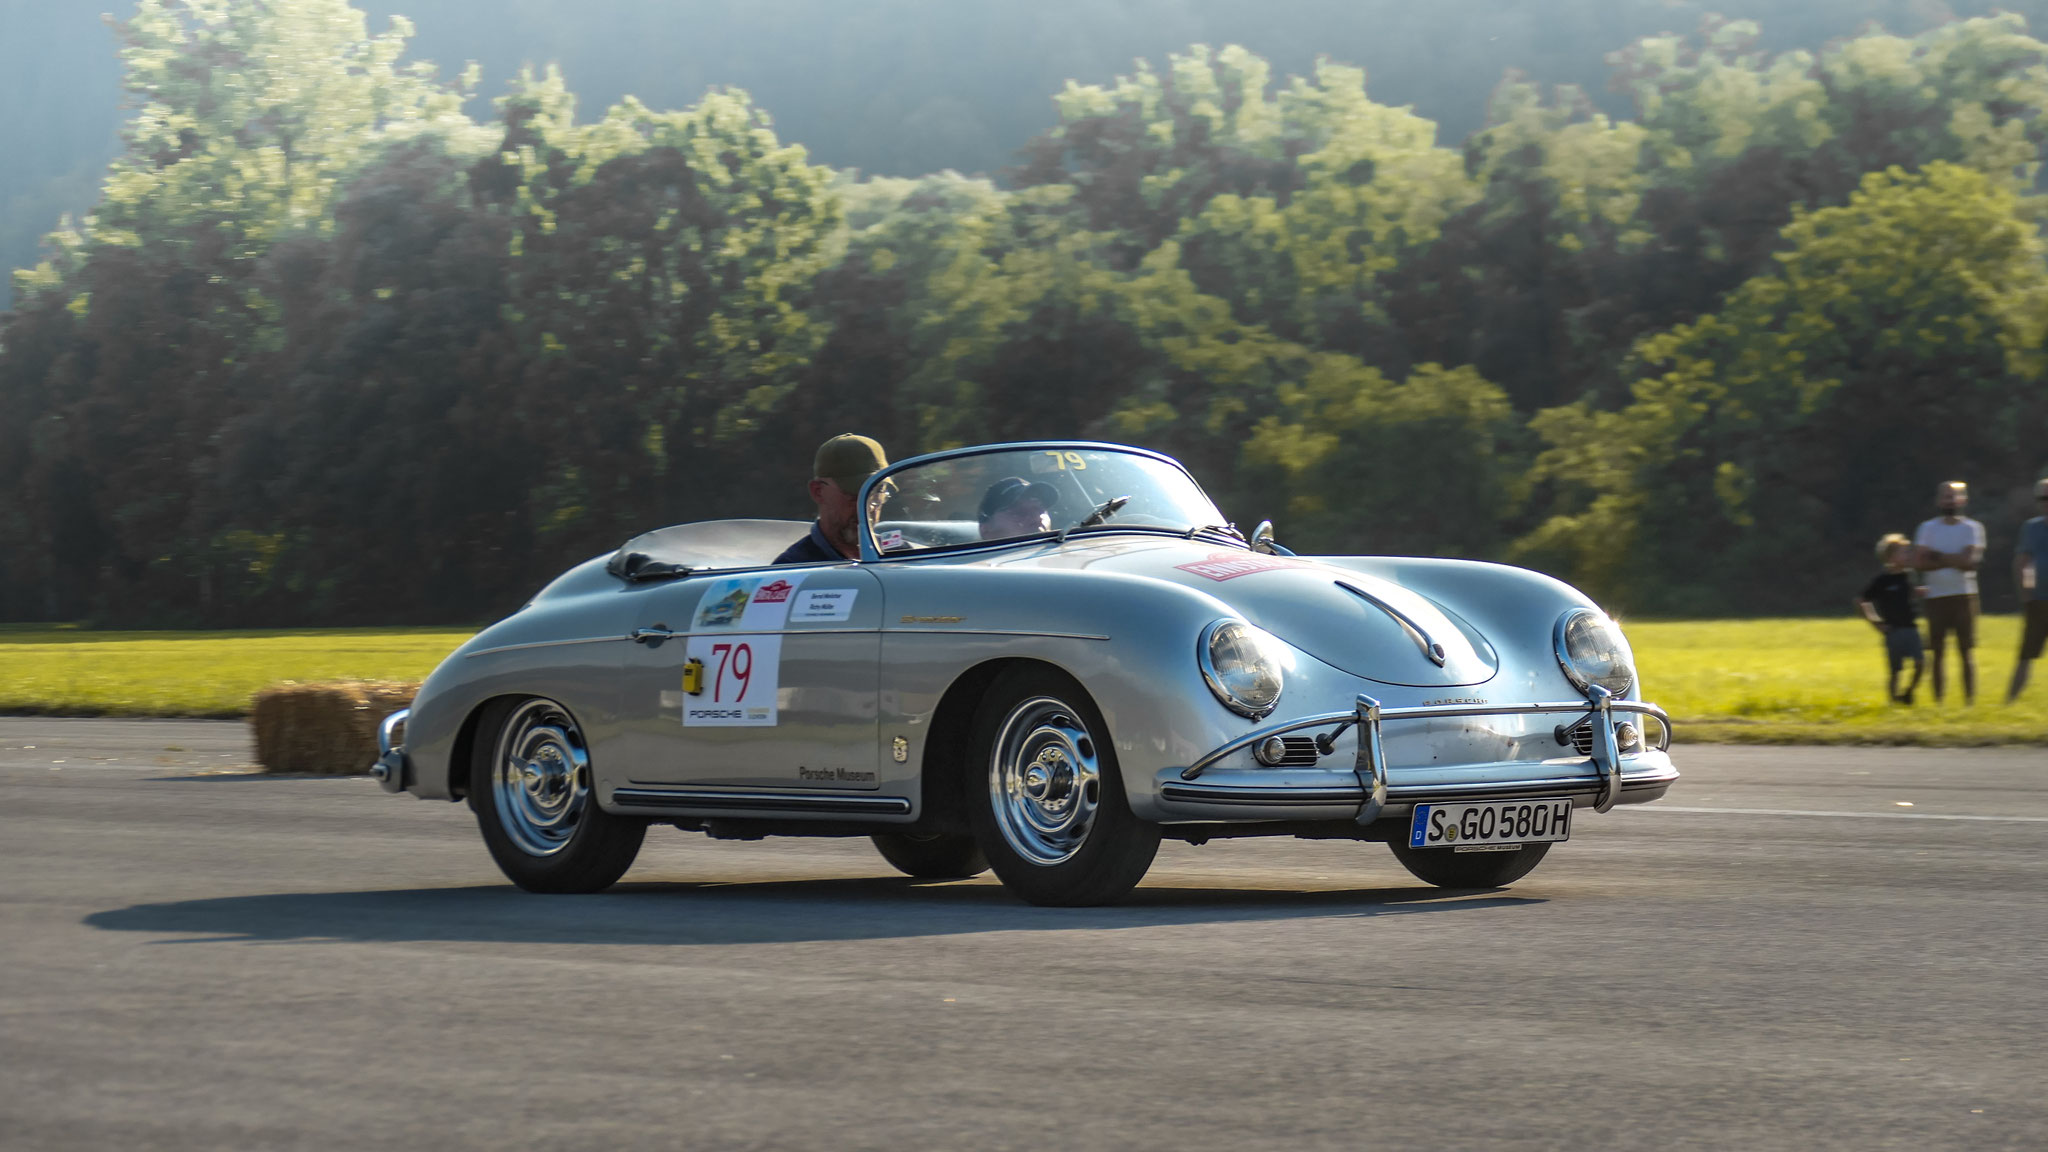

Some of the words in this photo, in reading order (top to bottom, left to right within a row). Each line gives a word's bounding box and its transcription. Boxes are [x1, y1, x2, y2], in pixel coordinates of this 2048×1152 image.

[1045, 451, 1087, 470] 79
[712, 643, 752, 702] 79
[689, 710, 742, 719] PORSCHE
[799, 766, 834, 781] Porsche
[836, 767, 875, 781] Museum
[1415, 830, 1422, 840] D
